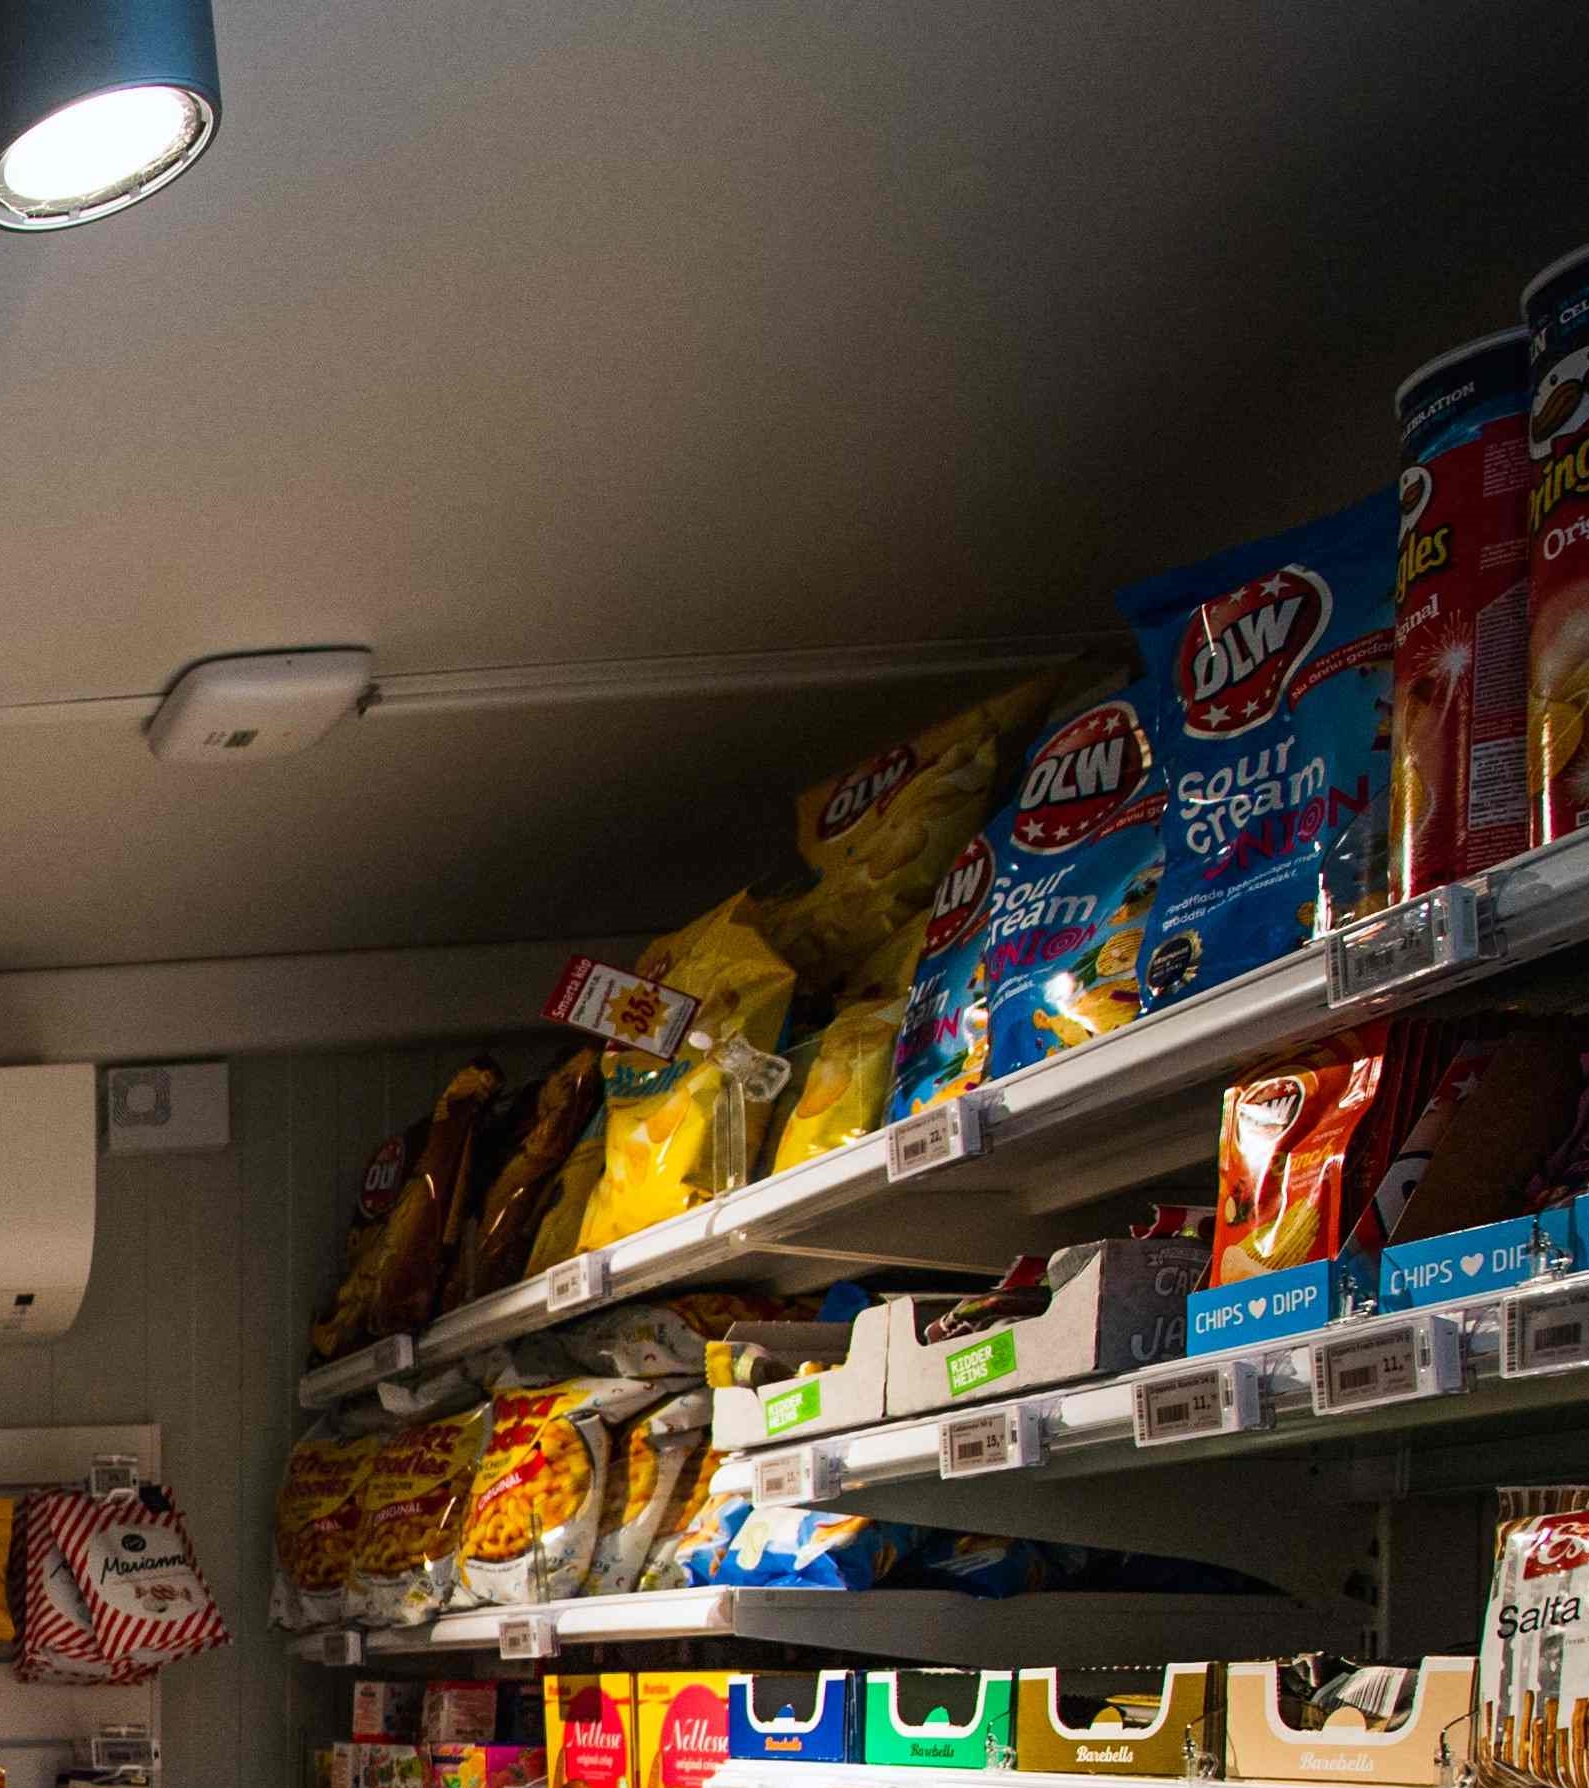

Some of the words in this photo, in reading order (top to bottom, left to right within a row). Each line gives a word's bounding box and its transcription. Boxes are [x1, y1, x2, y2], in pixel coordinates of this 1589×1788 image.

[1396, 523, 1451, 600] gles
[1194, 596, 1303, 701] OLW
[1346, 640, 1398, 667] godar
[1020, 738, 1124, 809] OLW
[1186, 756, 1326, 854] cream
[1390, 1258, 1454, 1294] CHIPS
[1492, 1243, 1530, 1274] DIP
[1195, 1302, 1245, 1335] CHIPS
[1272, 1285, 1318, 1317] DIPP
[950, 1344, 993, 1377] RIDDER
[952, 1364, 990, 1390] HEIMS
[1496, 1594, 1583, 1641] Salta
[1075, 1745, 1134, 1764] Barebells
[1299, 1751, 1375, 1773] Barebells
